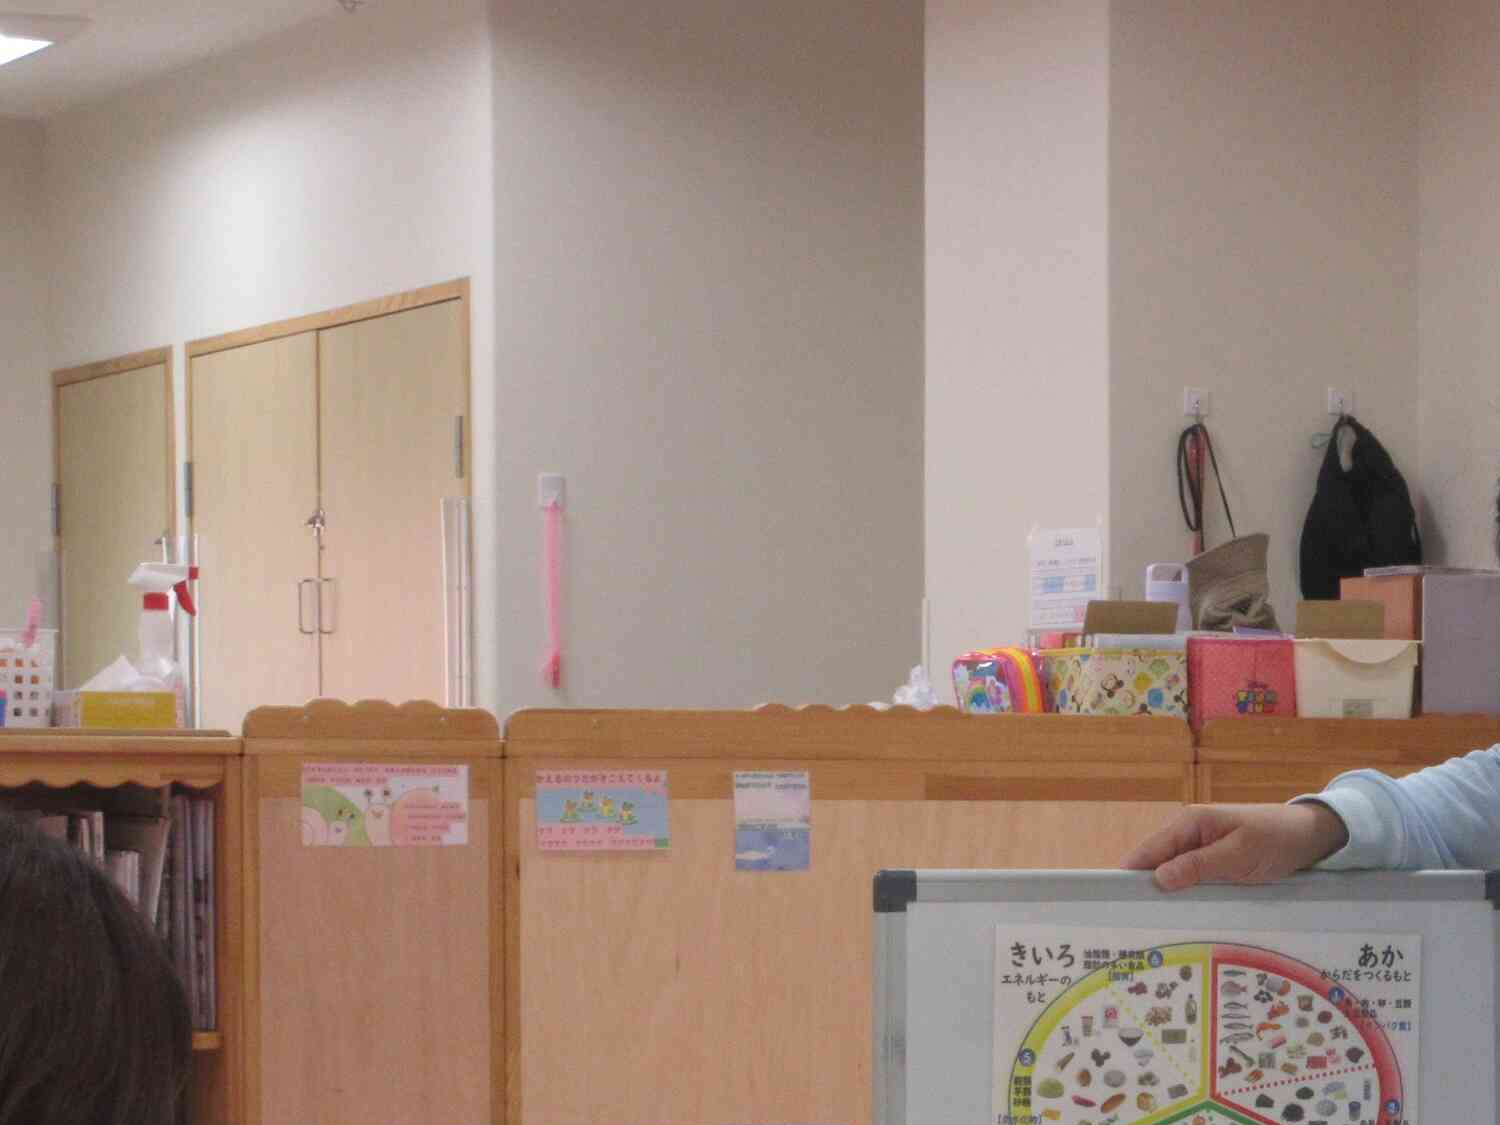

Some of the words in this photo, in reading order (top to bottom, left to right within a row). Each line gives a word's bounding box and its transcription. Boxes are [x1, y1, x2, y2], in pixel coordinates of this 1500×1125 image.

[1010, 942, 1075, 968] きいろ
[1358, 943, 1404, 968] あか
[1001, 974, 1072, 986] エネルギーの
[1320, 969, 1412, 982] からだをつくるもと
[1027, 992, 1046, 1004] もと
